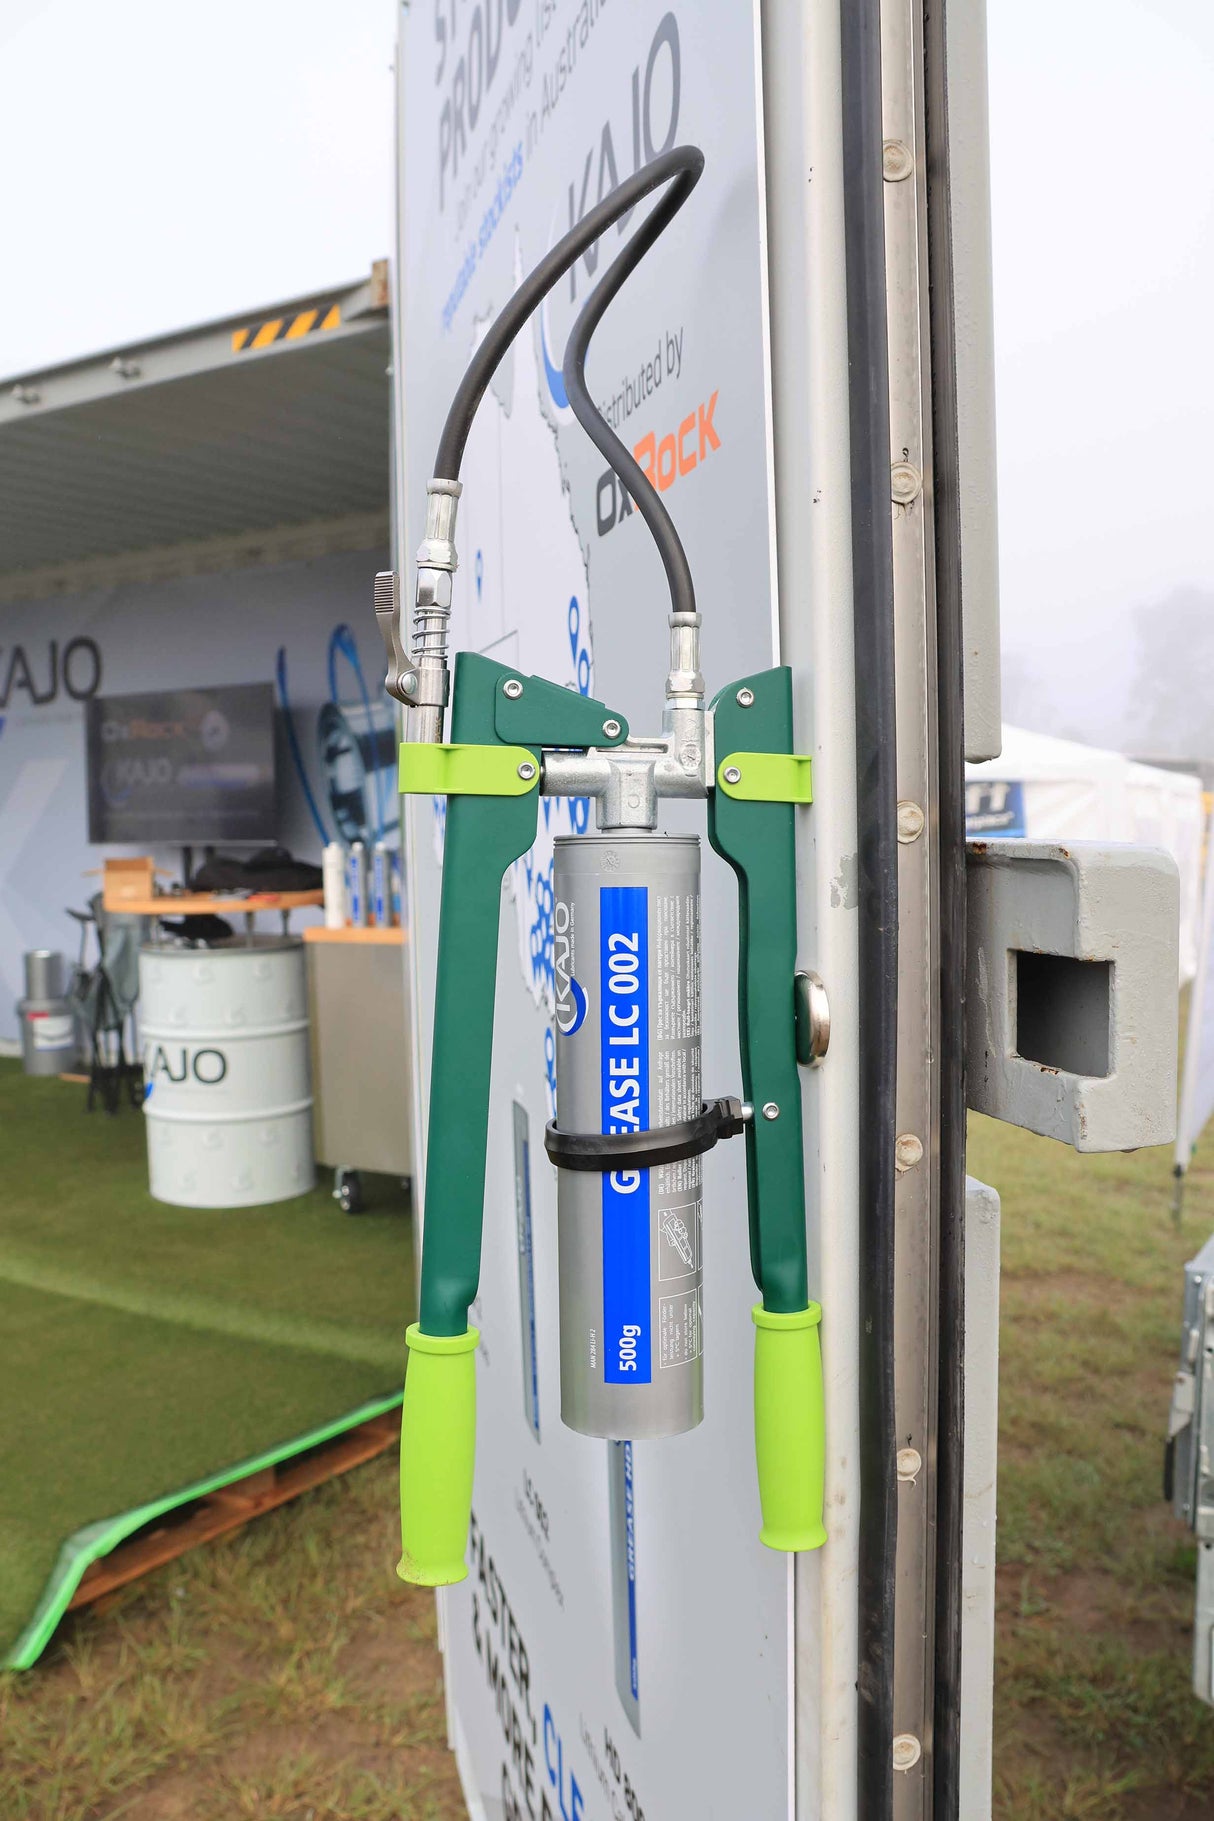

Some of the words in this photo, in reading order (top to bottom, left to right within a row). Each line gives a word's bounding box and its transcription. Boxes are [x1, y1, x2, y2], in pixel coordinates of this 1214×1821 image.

[438, 0, 521, 213] PROD
[567, 11, 681, 304] KAJO
[600, 338, 662, 429] istributed
[665, 326, 684, 380] by
[0, 635, 102, 707] AJO
[555, 901, 571, 1012] KAJO
[608, 932, 640, 994] 002
[149, 1045, 228, 1085] AJO
[609, 1004, 641, 1046] LC
[609, 1057, 641, 1195] GASE
[619, 1324, 642, 1371] 500g
[543, 1702, 586, 1821] CLE
